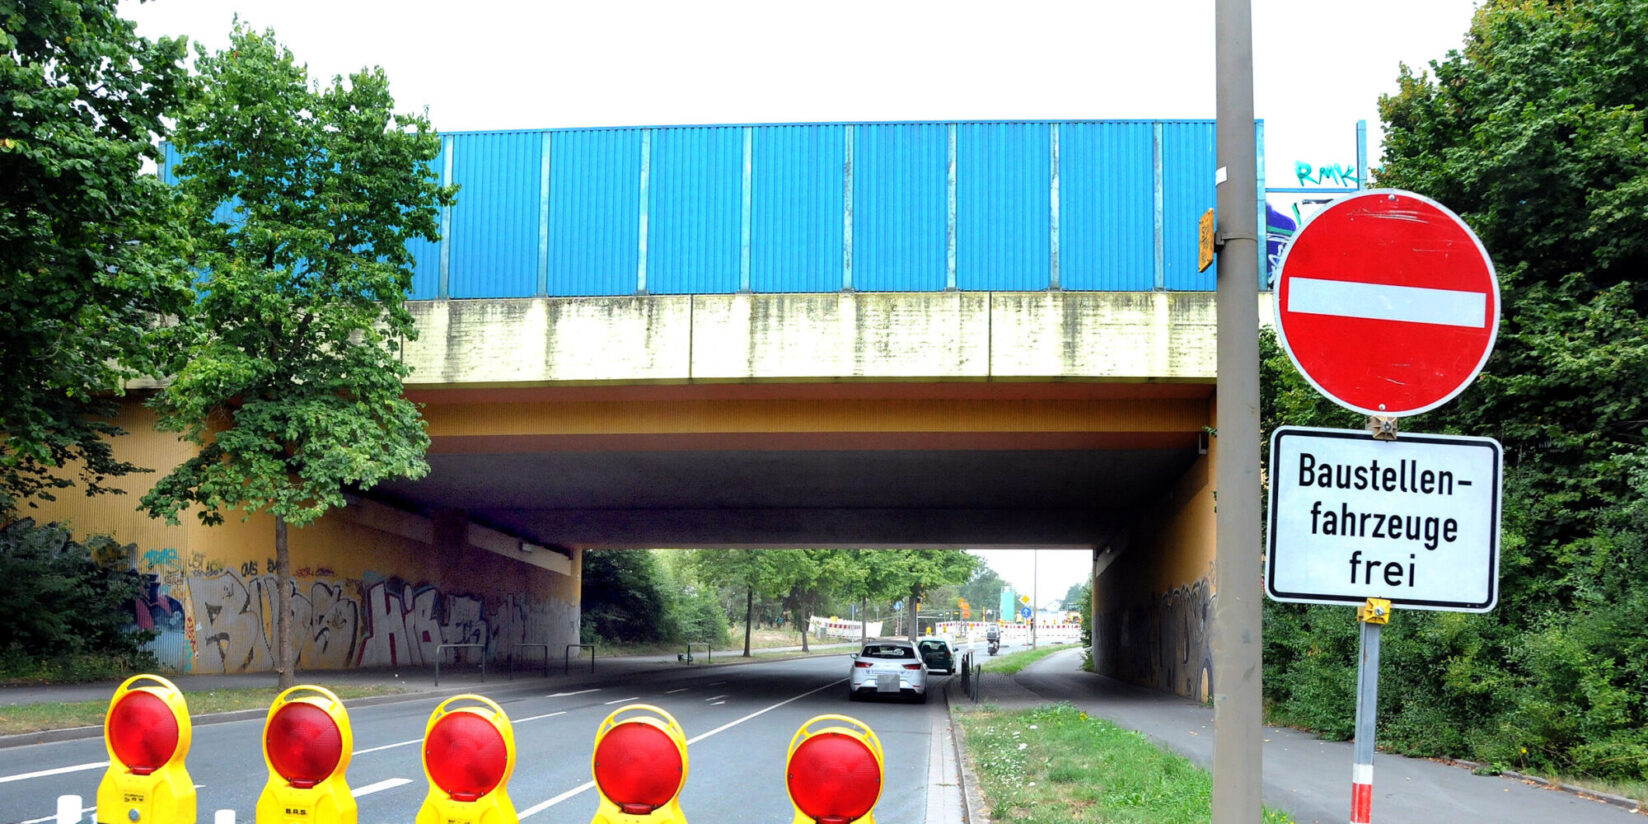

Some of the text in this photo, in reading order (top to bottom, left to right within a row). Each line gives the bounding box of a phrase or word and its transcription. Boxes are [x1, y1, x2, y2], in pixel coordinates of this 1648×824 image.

[1294, 160, 1358, 187] RMK
[1299, 453, 1473, 496] Baustellen-
[1310, 501, 1458, 551] fahrzeuge
[1349, 550, 1416, 587] frei
